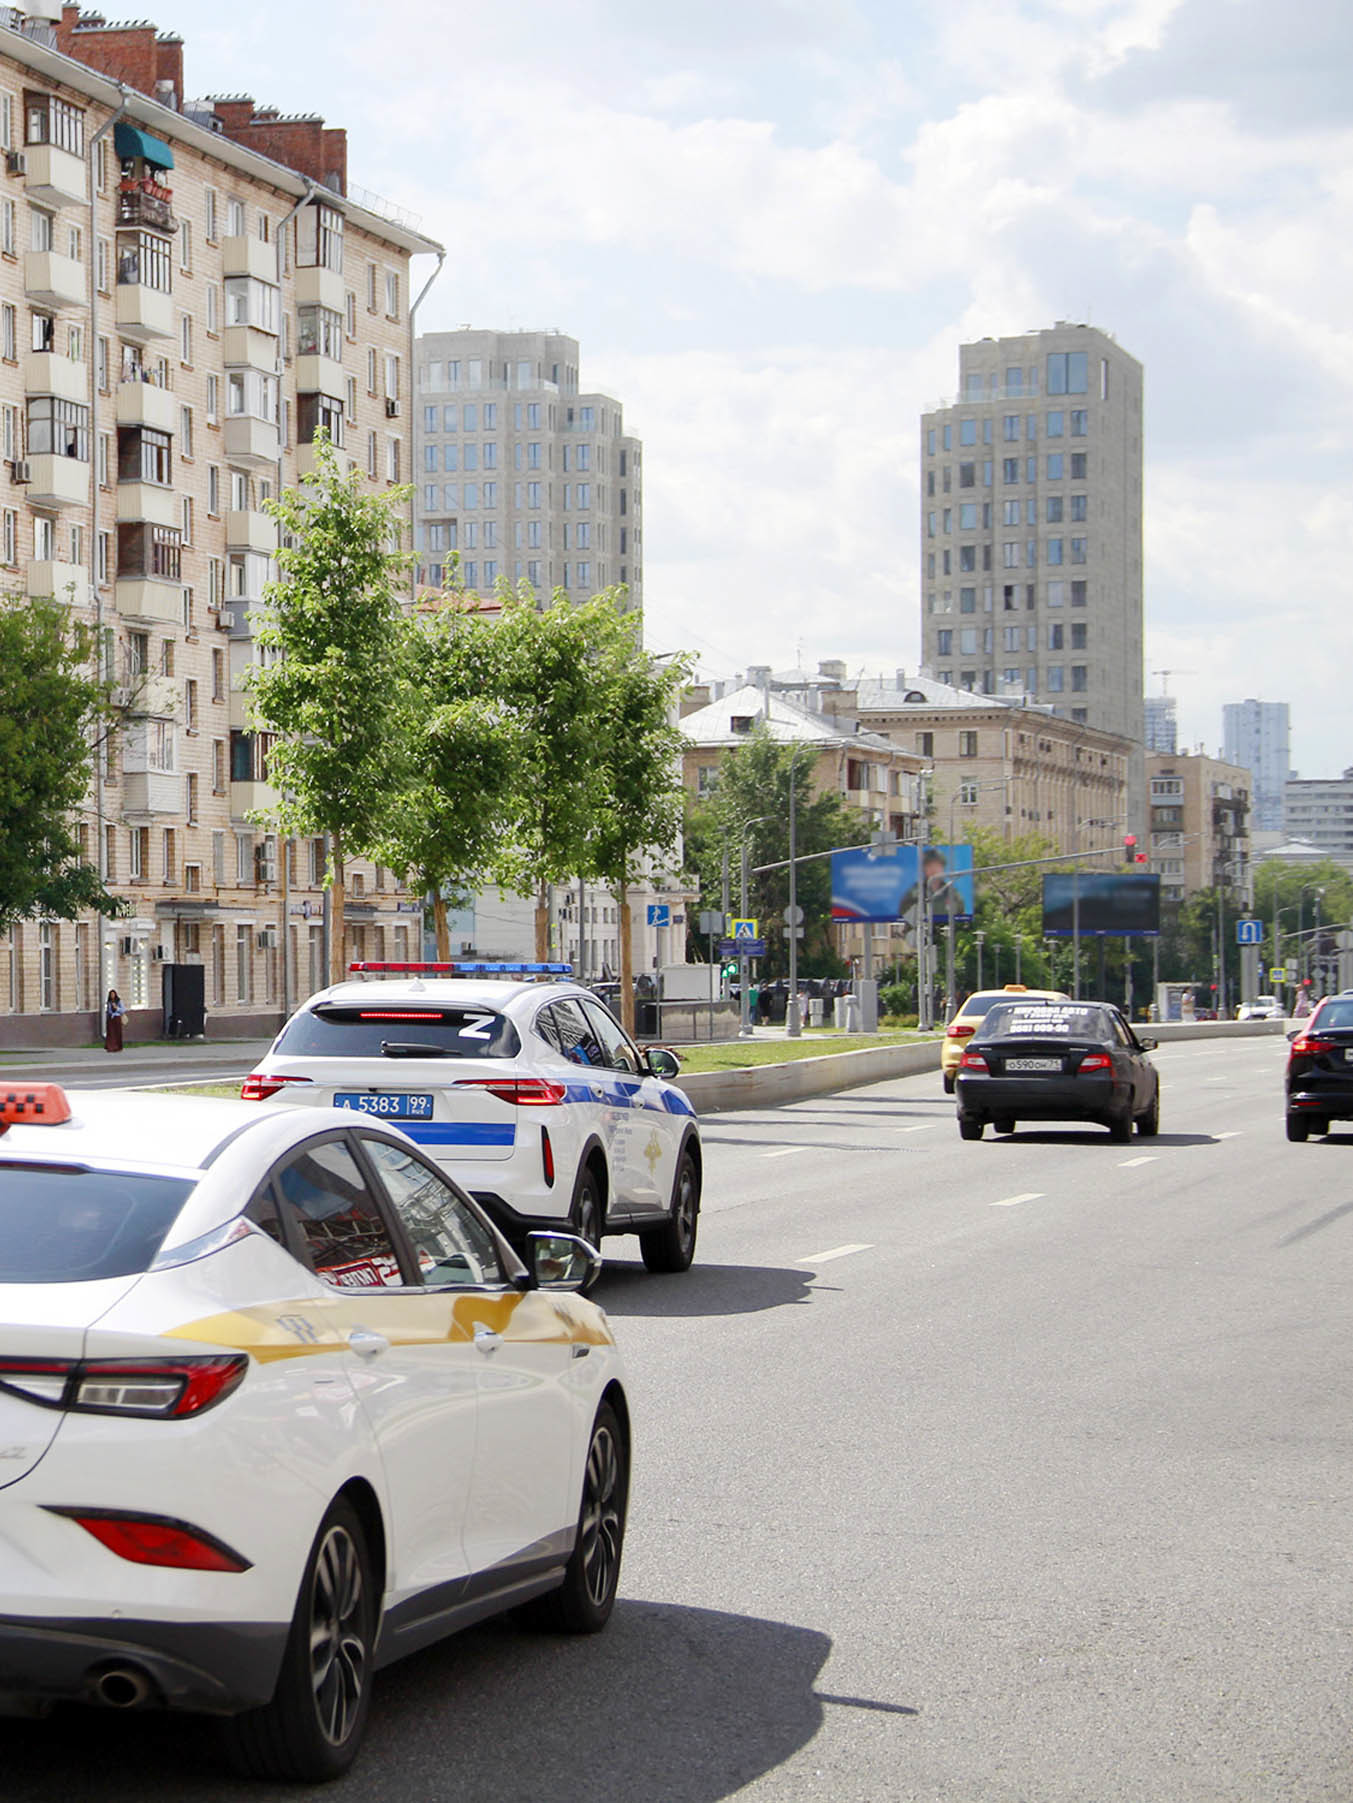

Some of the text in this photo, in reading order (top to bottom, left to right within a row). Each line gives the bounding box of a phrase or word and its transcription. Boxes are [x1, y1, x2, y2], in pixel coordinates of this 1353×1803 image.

[458, 1013, 496, 1040] Z
[358, 1096, 400, 1113] 5383
[410, 1096, 427, 1110] 99
